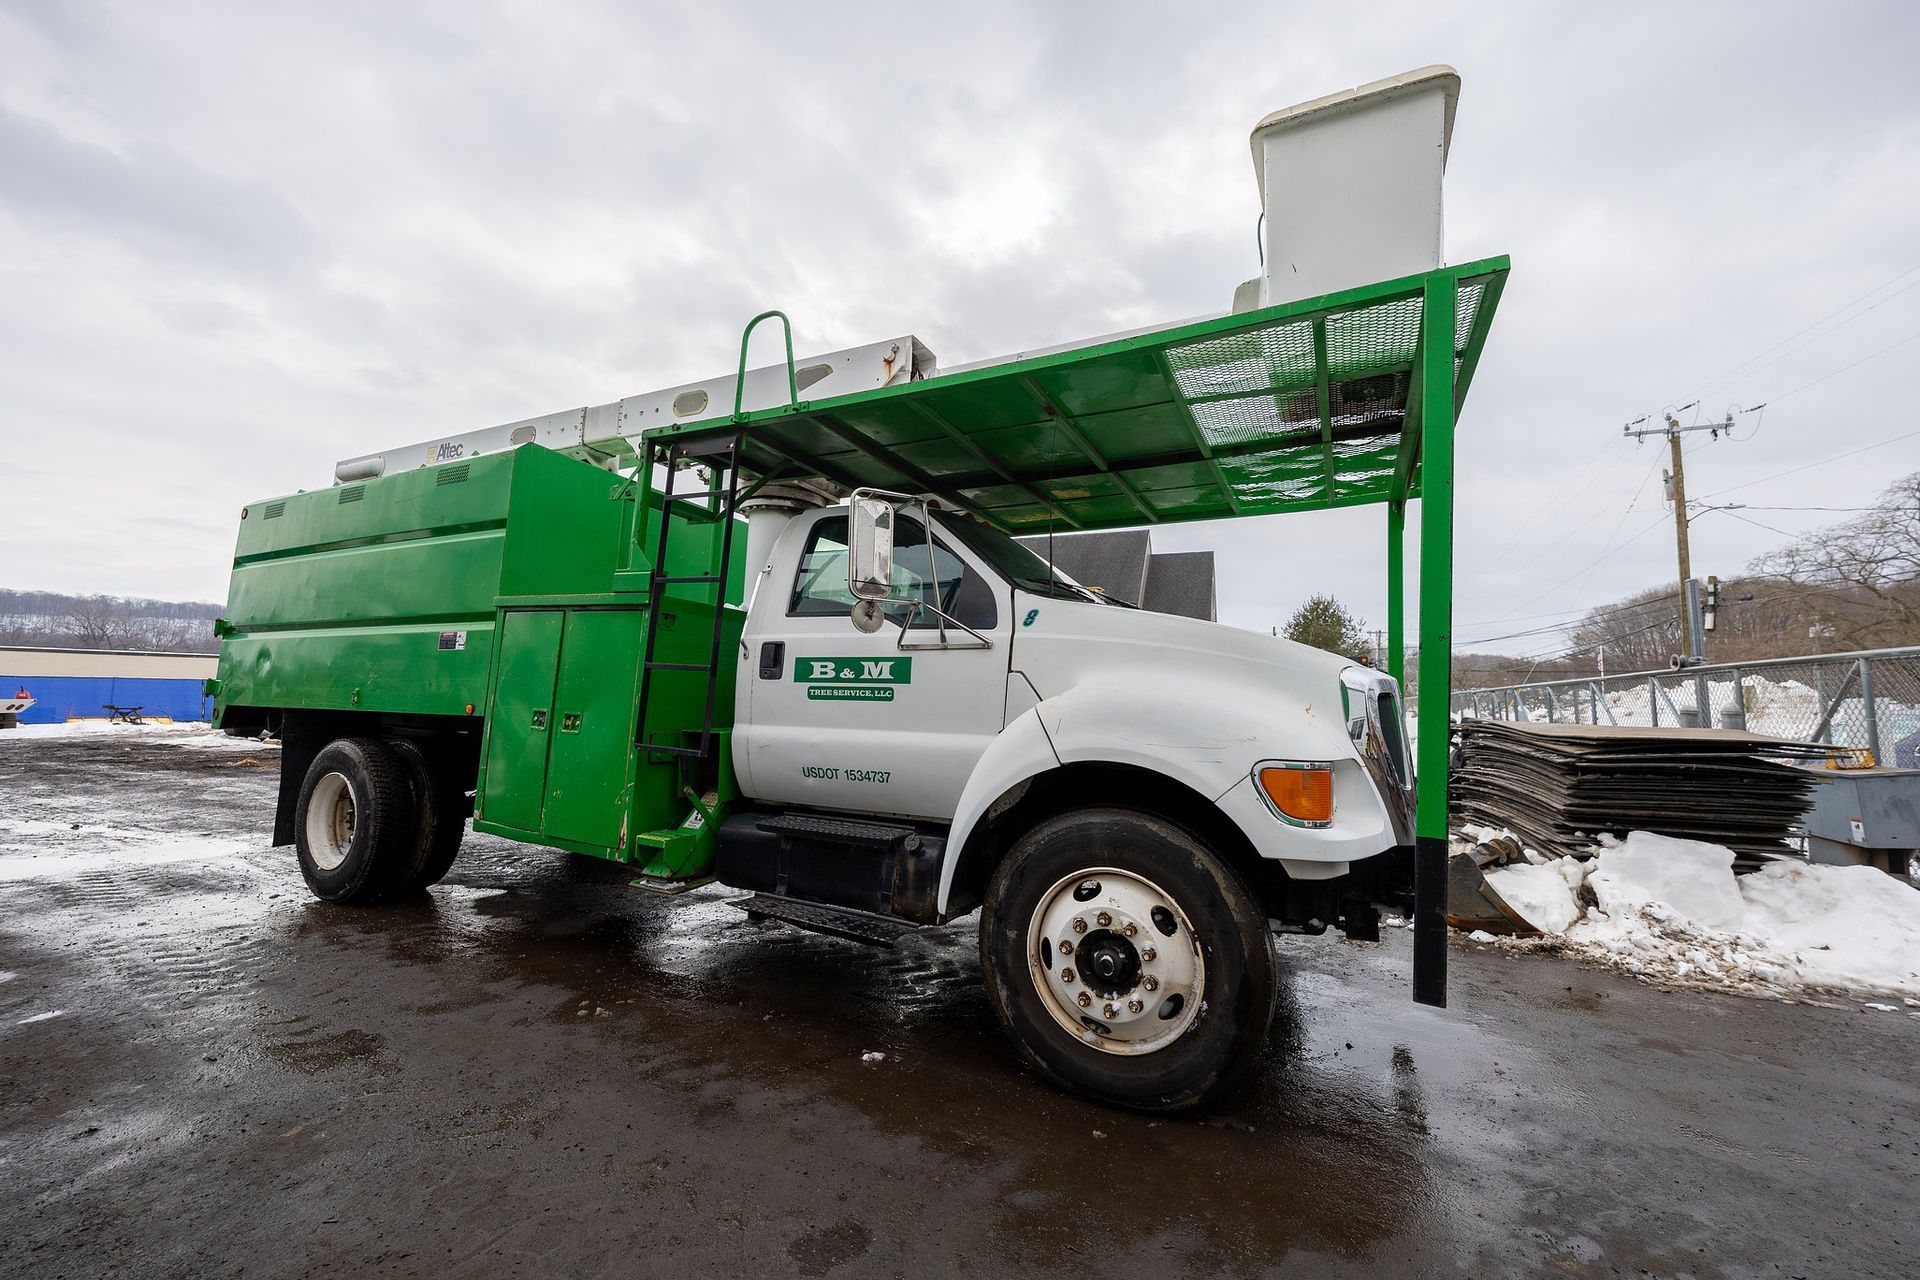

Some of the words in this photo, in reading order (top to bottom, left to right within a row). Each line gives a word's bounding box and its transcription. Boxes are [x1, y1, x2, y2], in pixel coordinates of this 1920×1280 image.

[437, 443, 463, 460] Altec
[1022, 608, 1040, 628] 8
[808, 661, 836, 679] B
[839, 667, 855, 679] &
[859, 661, 896, 679] M
[809, 689, 832, 697] TREE
[833, 689, 873, 698] SERVICE,
[875, 690, 892, 698] LLC
[802, 766, 839, 780] USDOT
[844, 769, 891, 783] 1534737
